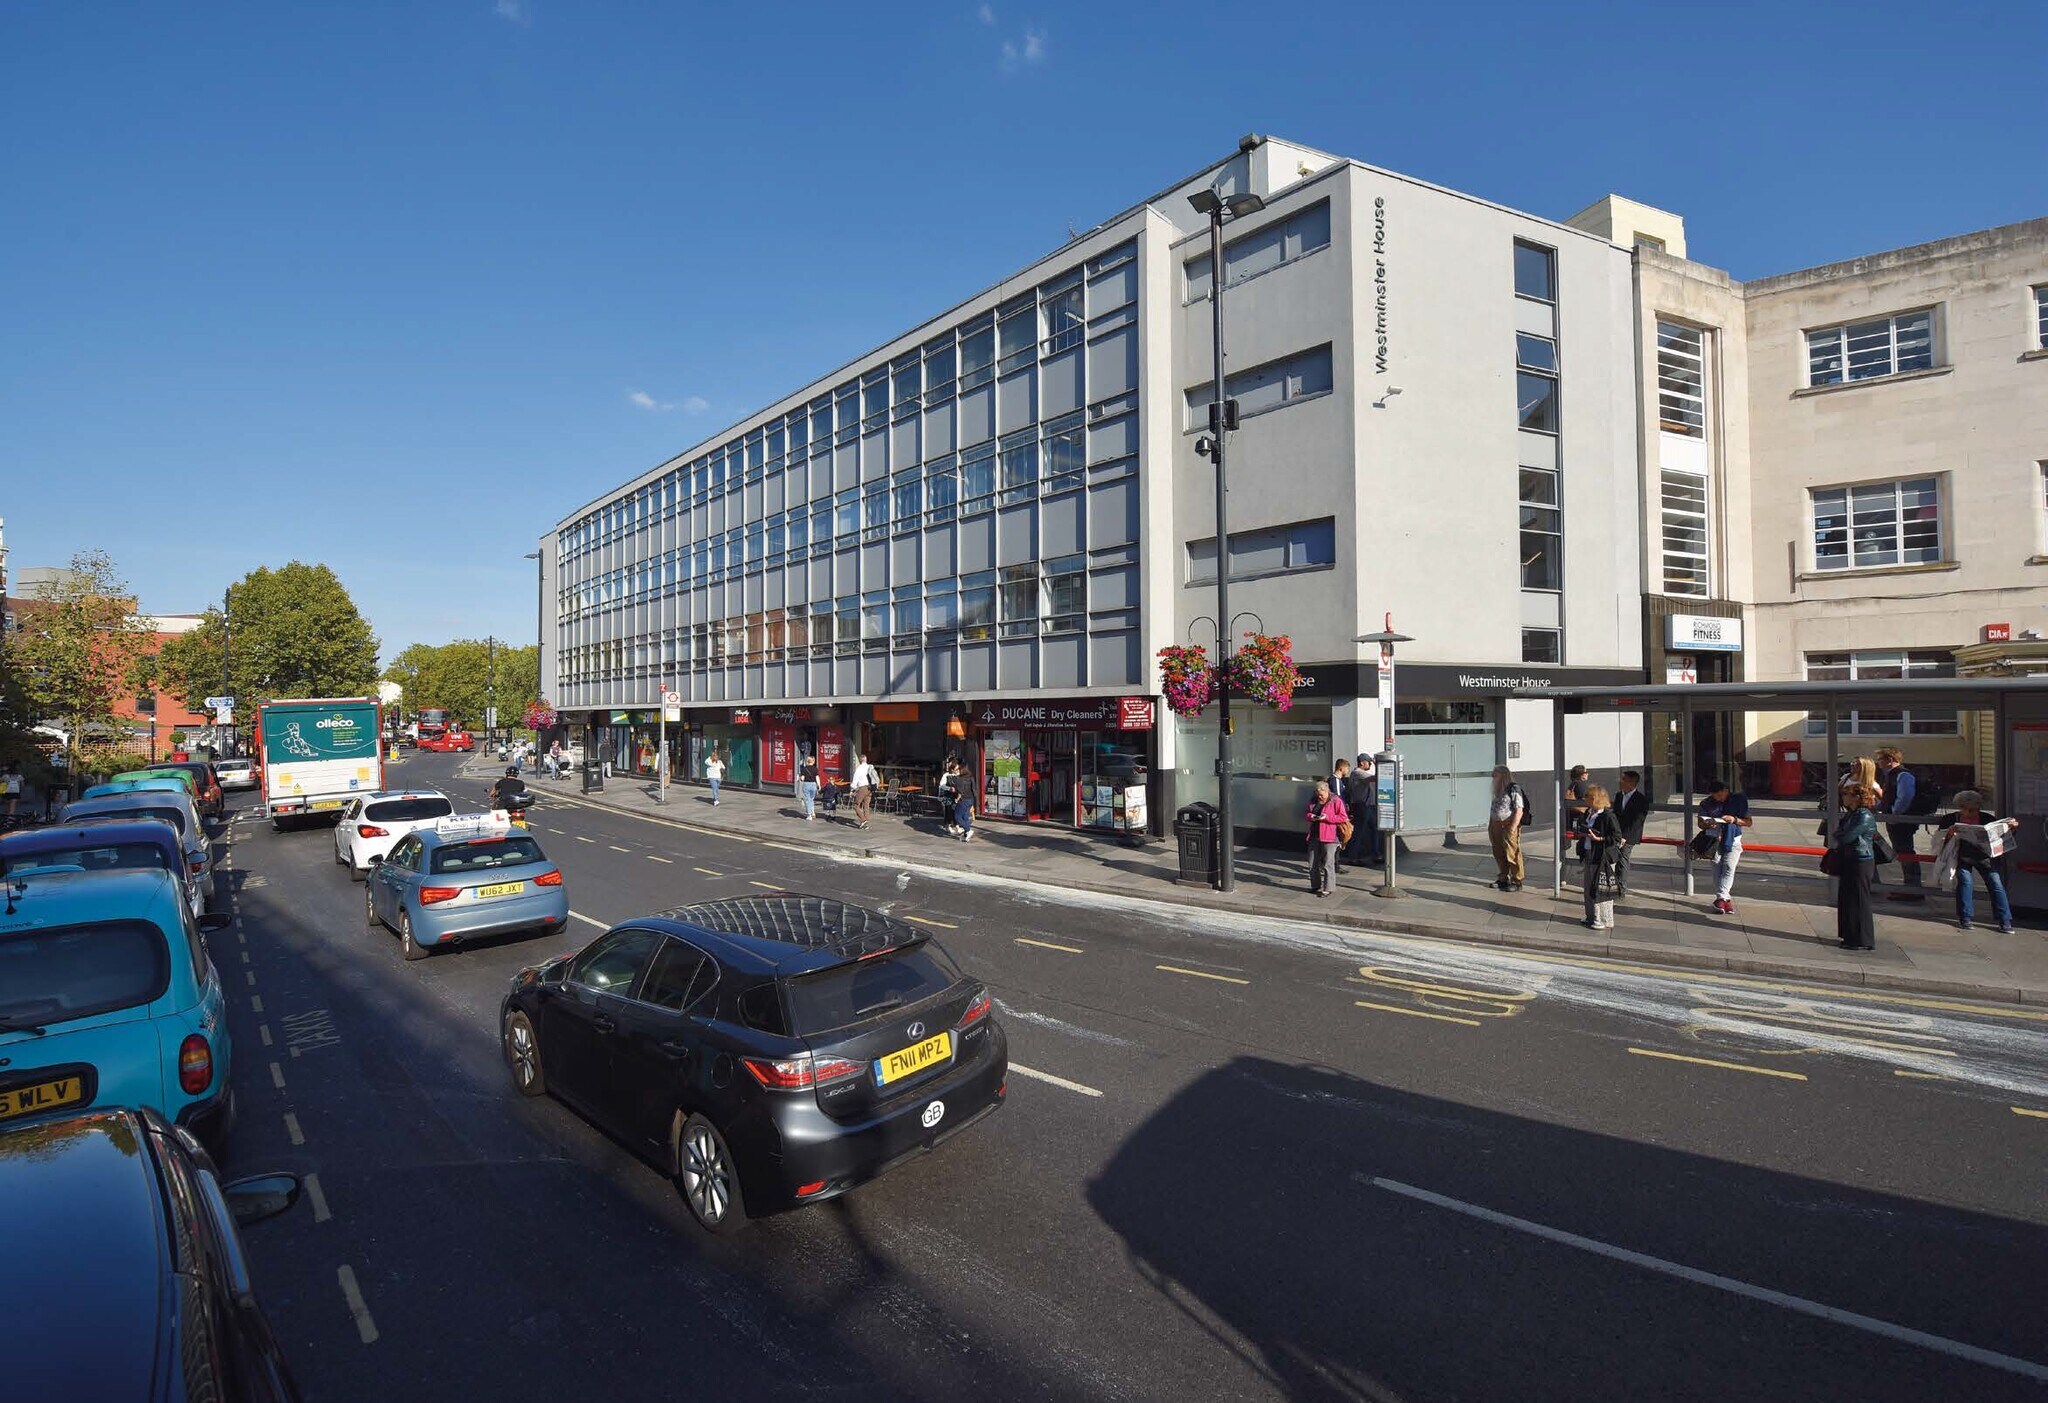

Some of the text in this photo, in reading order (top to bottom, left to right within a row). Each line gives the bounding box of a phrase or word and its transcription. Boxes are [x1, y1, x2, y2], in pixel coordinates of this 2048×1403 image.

[1373, 196, 1388, 374] Westminster House
[1693, 629, 1722, 640] FITNESS
[1459, 674, 1551, 688] Westminster House
[1002, 707, 1046, 720] DUCANE
[1051, 710, 1066, 721] Dry
[1066, 709, 1103, 719] Cleaners
[316, 718, 354, 728] olleco
[495, 813, 506, 822] L
[480, 883, 523, 897] WU62 JXT
[890, 1039, 944, 1075] FN11 MPZ
[19, 1081, 68, 1109] WLV
[924, 1104, 942, 1124] GB
